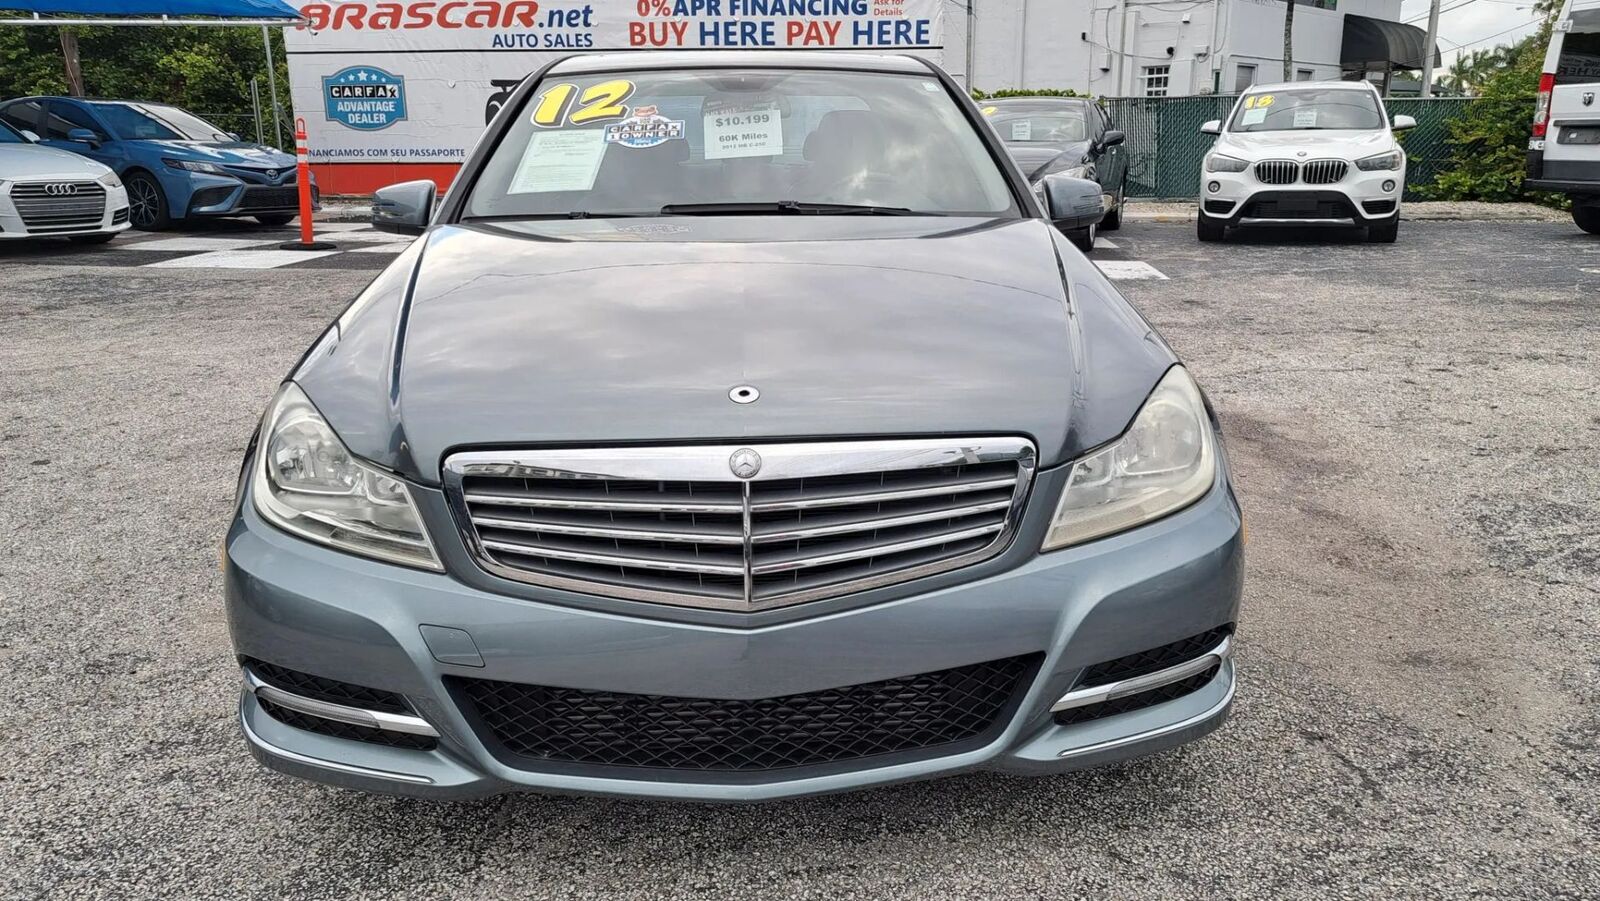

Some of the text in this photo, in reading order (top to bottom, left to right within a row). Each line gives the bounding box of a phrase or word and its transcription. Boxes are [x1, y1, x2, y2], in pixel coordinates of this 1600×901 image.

[729, 0, 867, 16] FINANCING
[874, 8, 903, 16] Details
[629, 20, 930, 46] BUY HERE PAY HERE
[492, 33, 593, 48] AUTO SALES
[331, 86, 398, 98] CARFAX
[337, 101, 396, 112] ADVANTAGE
[531, 79, 636, 127] 12
[348, 113, 387, 124] DEALER
[715, 114, 770, 127] $10.199
[609, 123, 679, 133] CARFAX
[719, 134, 739, 142] 60K
[309, 148, 465, 157] NANCIAMOS COM SEU PASSAPORTE
